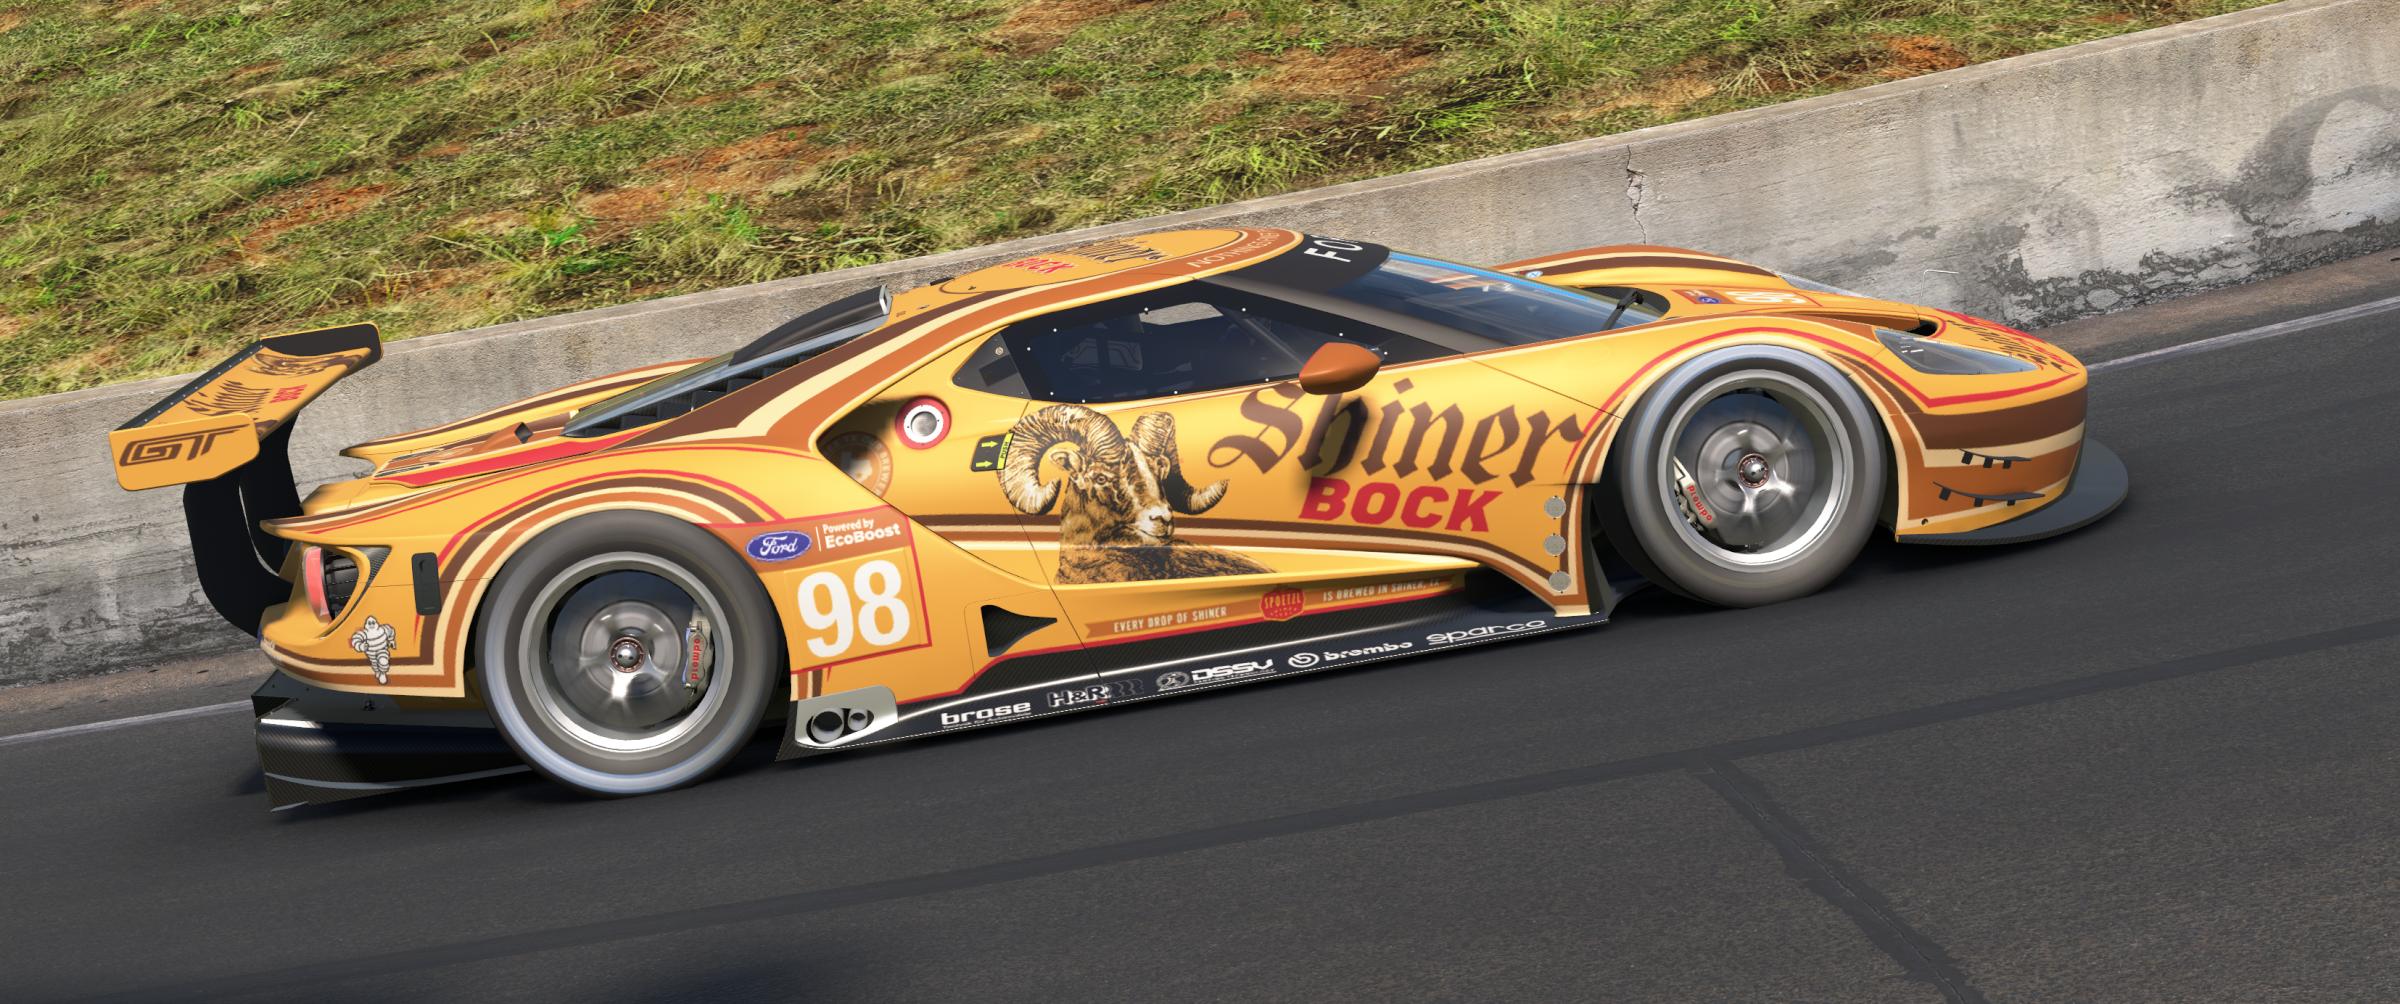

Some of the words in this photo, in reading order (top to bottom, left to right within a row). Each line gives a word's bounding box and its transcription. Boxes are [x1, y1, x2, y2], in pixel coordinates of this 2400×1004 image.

[119, 423, 252, 467] GT
[1206, 377, 1587, 489] Shiner
[999, 441, 1010, 460] PUSH
[1298, 476, 1503, 533] BOCK
[822, 520, 861, 534] Powered
[862, 517, 874, 530] by
[824, 522, 901, 549] EcoBoost
[759, 535, 798, 556] Ford
[1323, 591, 1333, 603] IS
[1336, 586, 1375, 602] BREWED
[1378, 584, 1388, 595] IN
[797, 559, 911, 658] 98
[1113, 617, 1145, 633] EVERY
[1148, 613, 1174, 629] DROP
[1177, 611, 1188, 625] OF
[1192, 606, 1227, 623] SHINER
[1426, 619, 1547, 644] sparco
[1324, 642, 1413, 662] brembo
[1191, 658, 1273, 682] DSSV
[1046, 684, 1112, 709] H&R
[940, 701, 1032, 727] brose
